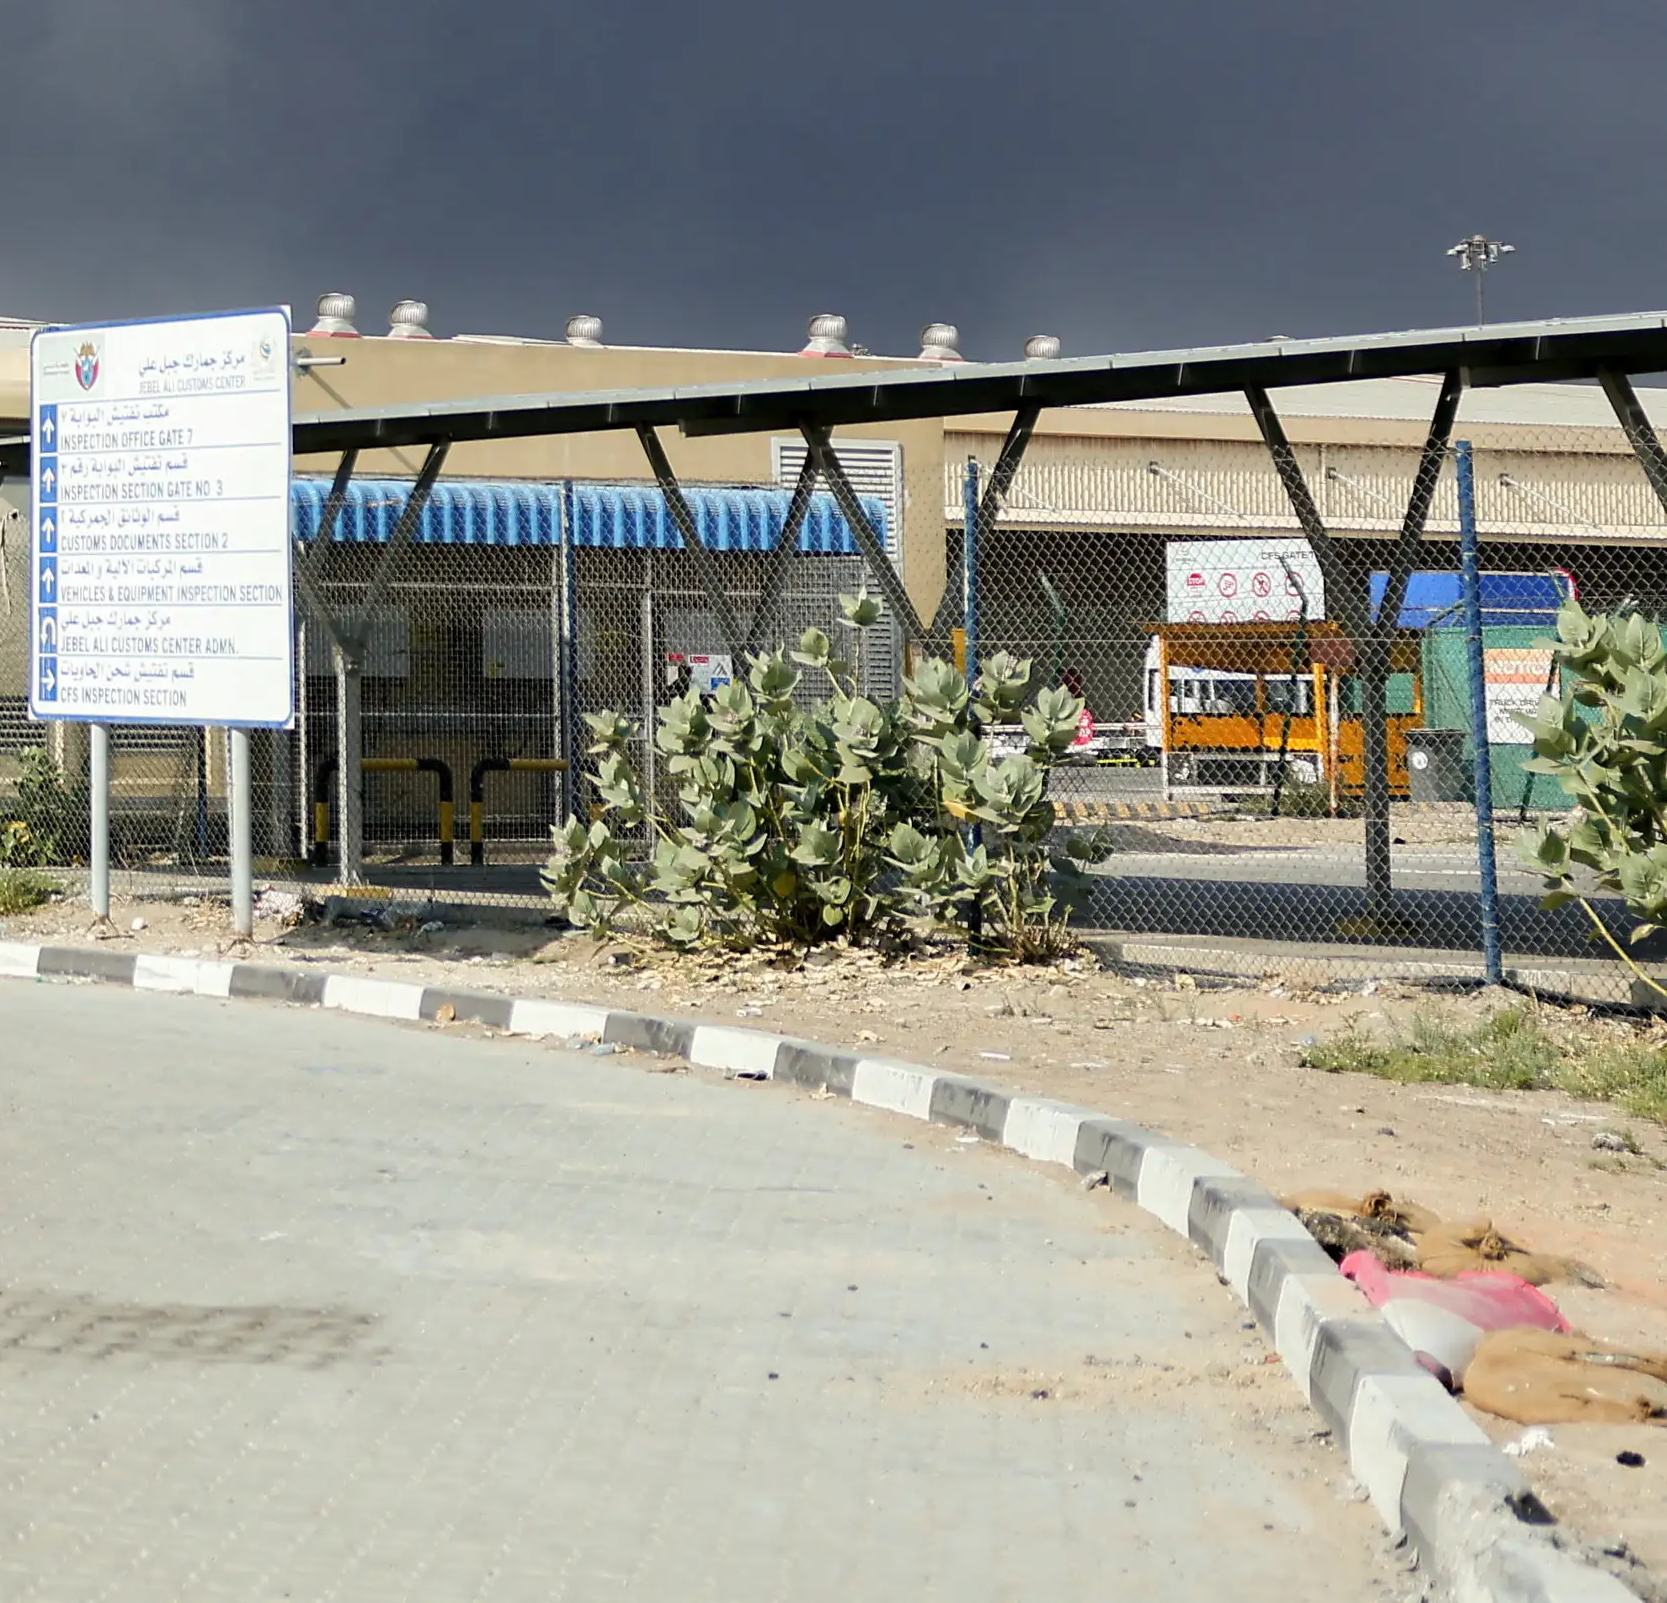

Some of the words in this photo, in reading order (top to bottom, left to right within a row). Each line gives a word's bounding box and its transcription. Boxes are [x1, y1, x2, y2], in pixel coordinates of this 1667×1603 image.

[138, 357, 156, 377] علي
[159, 356, 180, 374] جبل
[184, 353, 217, 372] جمارك
[221, 350, 245, 367] مركز
[138, 380, 162, 394] JEBEL
[163, 379, 176, 393] ALI
[177, 377, 214, 392] CUSTOMS
[215, 375, 246, 390] CENTER
[60, 433, 118, 450] INSPECTION
[121, 431, 156, 448] OFFICE
[159, 429, 184, 446] GATE
[187, 429, 193, 444] 7
[60, 484, 118, 501] INSPECTION
[121, 482, 164, 499] SECTION
[167, 481, 193, 498] GATE
[216, 480, 223, 496] 3
[60, 535, 107, 551] CUSTOMS
[110, 533, 171, 550] DOCUMENTS
[174, 532, 219, 549] SECTION
[222, 532, 228, 548] 2
[1261, 551, 1280, 560] CFS
[1282, 550, 1308, 559] GATE
[60, 585, 106, 602] VEHICLES
[108, 585, 114, 602] &
[118, 584, 174, 602] EQUIPMENT
[177, 584, 236, 602] INSPECTION
[240, 584, 282, 602] SECTION
[61, 611, 79, 631] علي
[82, 611, 103, 631] جبل
[107, 611, 141, 630] جمارك
[145, 611, 171, 630] مركز
[61, 636, 90, 652] JEBEL
[93, 636, 108, 652] ALI
[111, 636, 159, 653] CUSTOMS
[161, 637, 202, 654] CENTER
[60, 686, 78, 704] CFS
[81, 688, 140, 706] INSPECTION
[143, 690, 187, 707] SECTION
